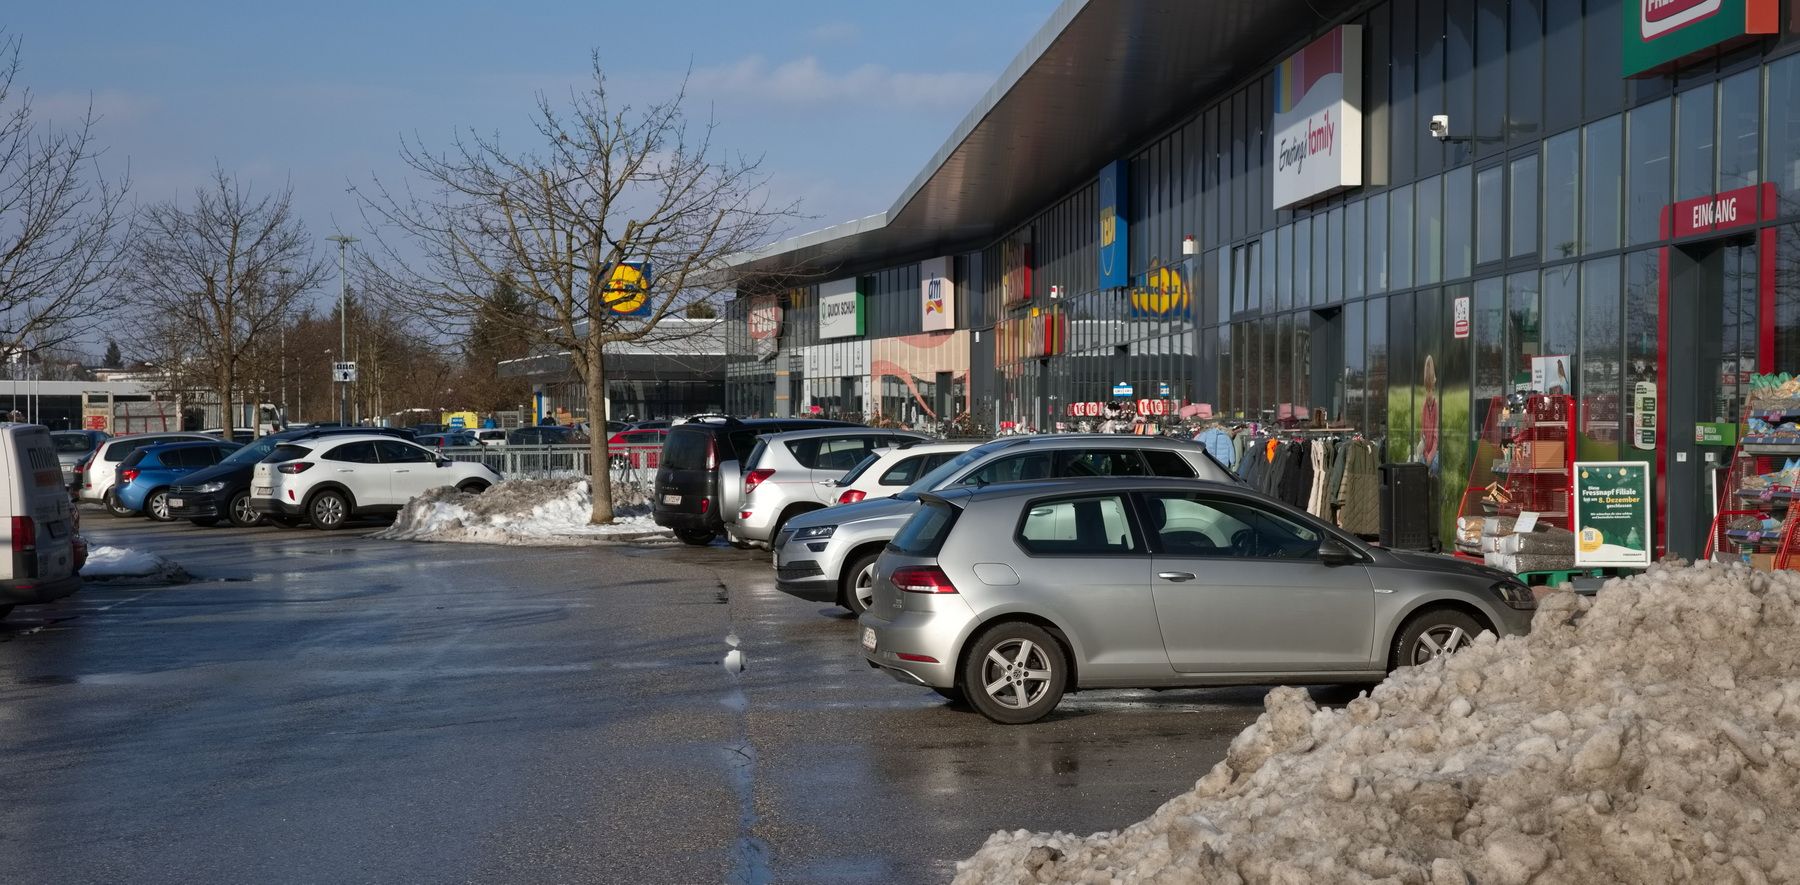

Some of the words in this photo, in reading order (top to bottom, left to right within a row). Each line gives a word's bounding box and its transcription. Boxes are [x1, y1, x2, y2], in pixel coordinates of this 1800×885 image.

[1308, 109, 1335, 156] family
[1693, 197, 1737, 228] EINGANG
[929, 273, 941, 299] dm
[827, 302, 841, 318] QUICK
[841, 300, 856, 316] SCHUH
